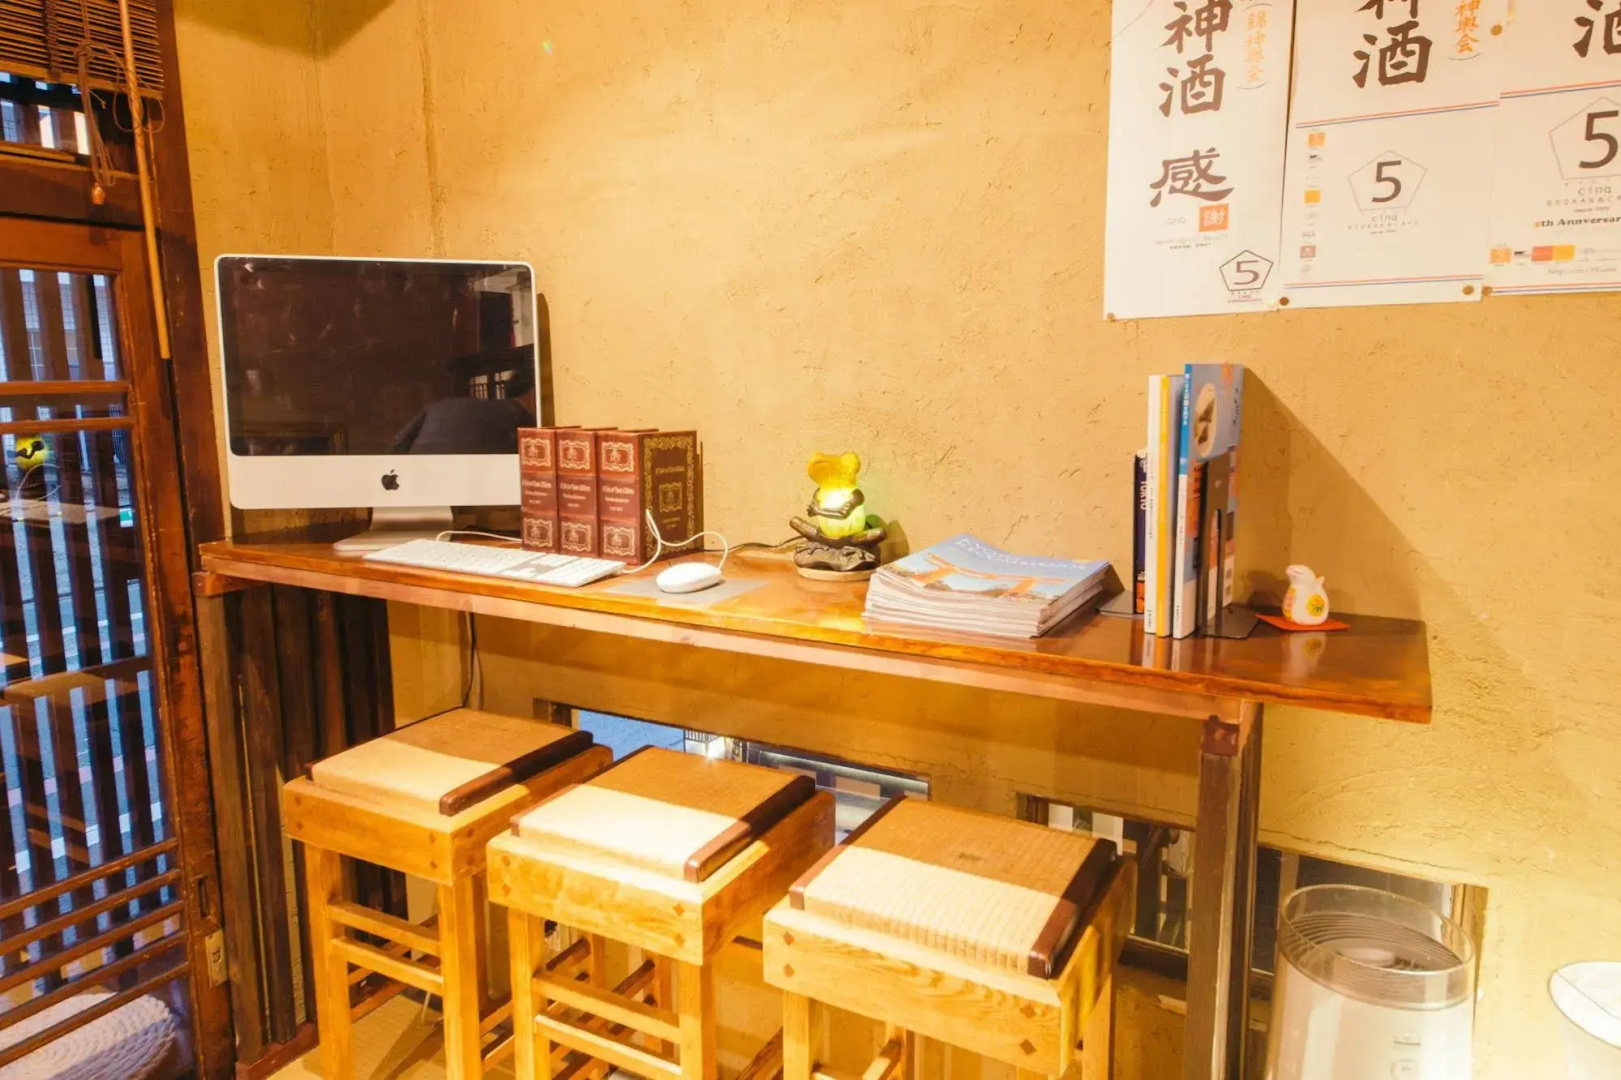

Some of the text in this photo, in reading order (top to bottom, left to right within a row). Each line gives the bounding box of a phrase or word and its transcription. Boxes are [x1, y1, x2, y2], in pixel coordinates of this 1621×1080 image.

[1579, 110, 1619, 169] 5
[1150, 147, 1235, 208] 感
[1371, 160, 1402, 203] 5
[1234, 260, 1260, 286] 5
